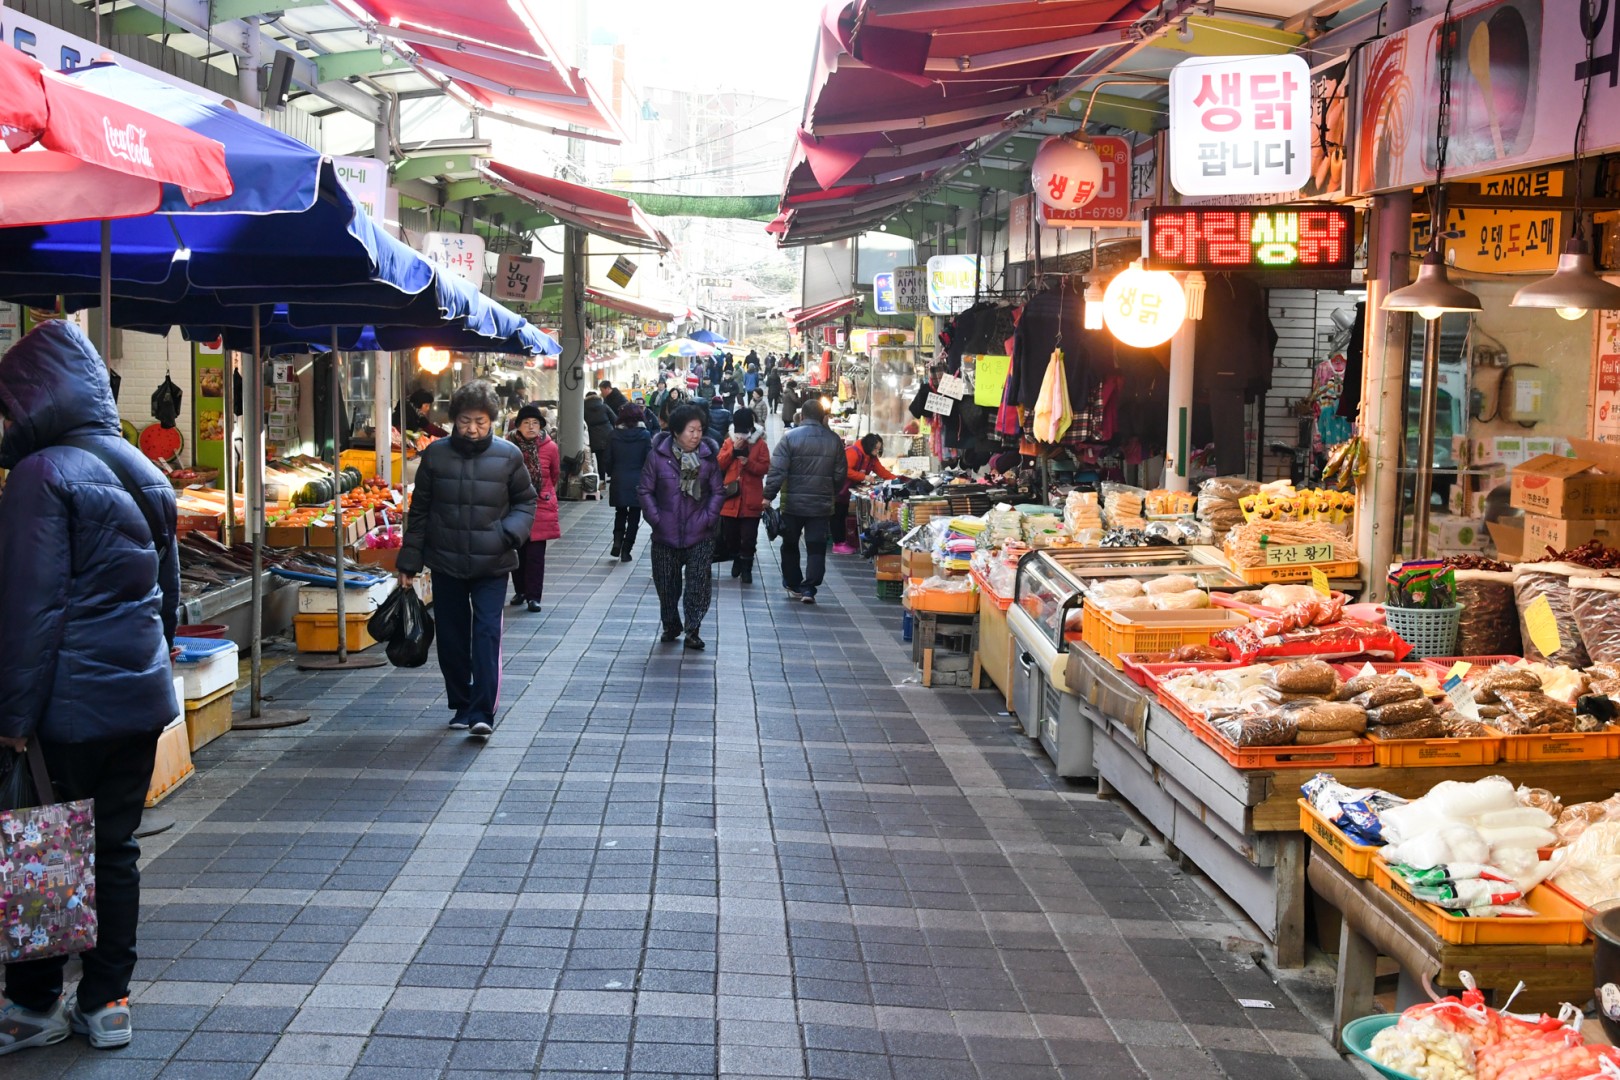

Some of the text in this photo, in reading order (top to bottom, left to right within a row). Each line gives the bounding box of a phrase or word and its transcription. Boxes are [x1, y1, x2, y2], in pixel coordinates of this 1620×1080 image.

[1193, 71, 1298, 132] 생닭
[103, 115, 154, 169] Coca-Cola
[1198, 139, 1295, 177] 팝니다
[1047, 173, 1095, 204] 생닭
[441, 237, 465, 249] 부산
[1154, 211, 1347, 264] 하림생닭
[1117, 287, 1162, 325] 생닭
[1269, 544, 1332, 563] 국산 황기
